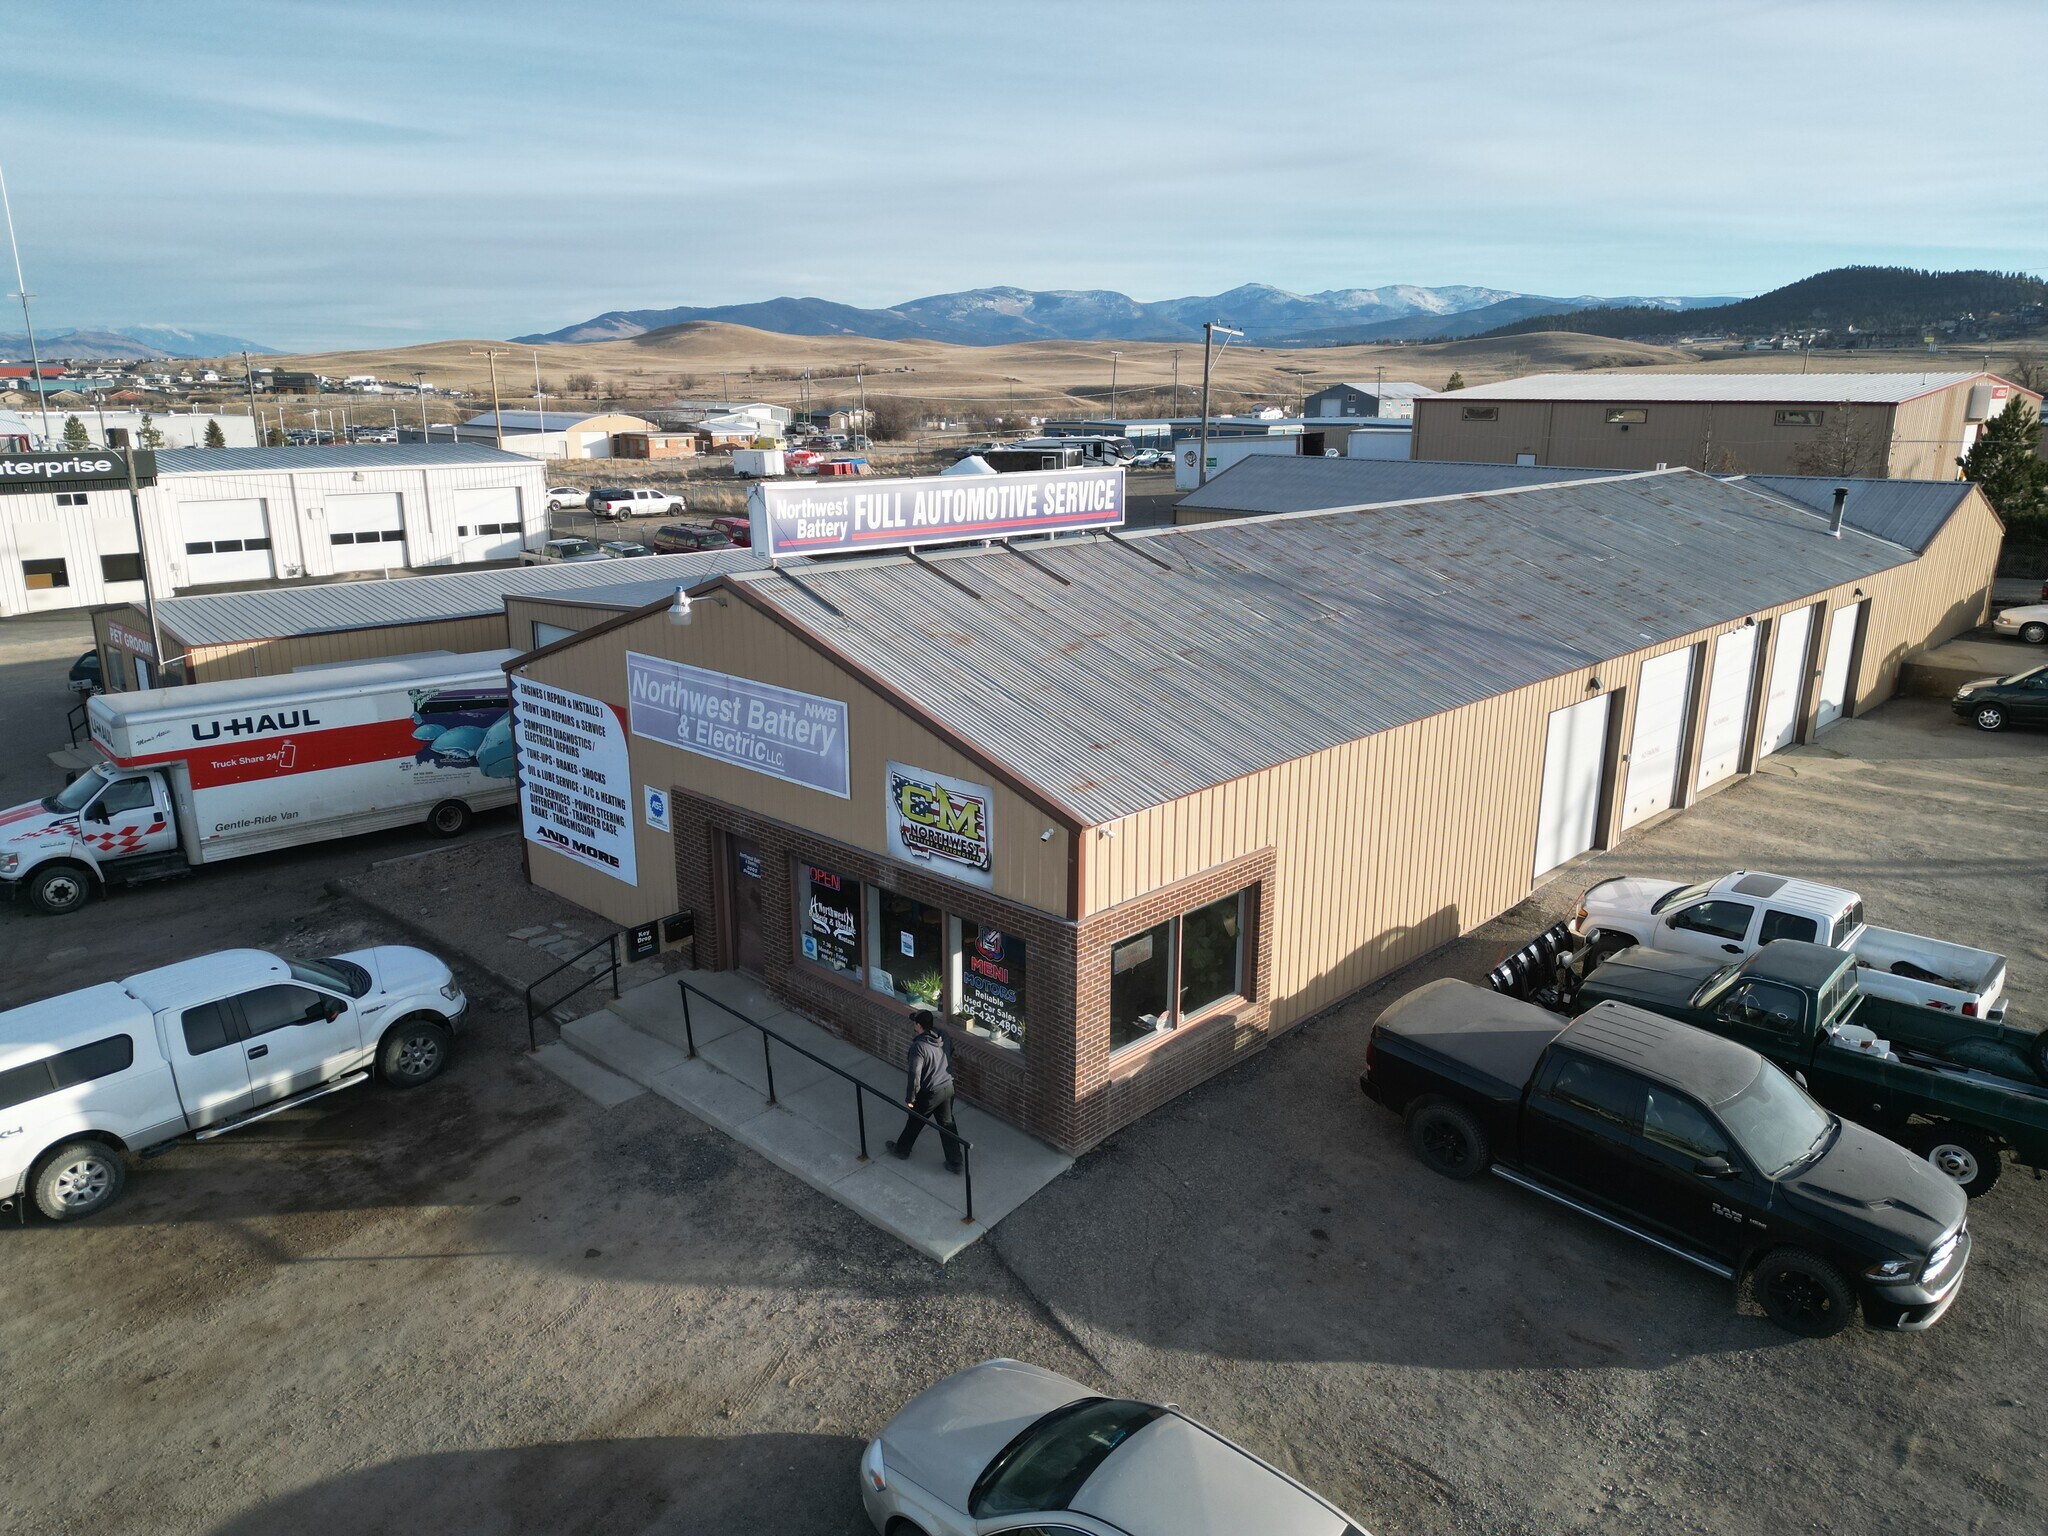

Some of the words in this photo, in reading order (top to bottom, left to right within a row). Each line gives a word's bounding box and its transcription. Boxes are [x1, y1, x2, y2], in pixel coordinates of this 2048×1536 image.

[0, 457, 112, 478] terprise
[776, 497, 848, 520] Northwest
[854, 493, 906, 530] FULL
[913, 484, 1037, 526] AUTOMOTIVE
[1043, 479, 1116, 515] SERVICE
[797, 519, 848, 542] Battery
[109, 627, 123, 645] PET
[521, 683, 543, 700] ENGINES
[547, 692, 567, 707] REPAIR
[573, 699, 600, 718] INSTALLS
[633, 669, 741, 725] Northwest
[748, 699, 837, 757] Battery
[804, 702, 837, 723] NWB
[191, 709, 321, 741] U-HAUL
[522, 701, 539, 715] FRONT
[540, 706, 550, 719] END
[551, 709, 575, 728] REPAIRS
[581, 720, 606, 738] SERVICE
[524, 719, 553, 737] COMPUTER
[553, 728, 592, 751] DIAGNOSTICS
[525, 731, 555, 750] ELECTRICAL
[556, 742, 580, 758] REPAIRS
[677, 714, 689, 739] &
[696, 719, 766, 761] Electric
[211, 758, 238, 769] Truck
[238, 755, 265, 765] Share
[266, 750, 286, 762] 24/7
[526, 747, 553, 765] TUNE-UPS
[556, 758, 578, 775] BRAKES
[582, 767, 606, 784] SHOCKS
[527, 765, 536, 776] OIL
[541, 770, 555, 783] LUBE
[556, 775, 579, 793] SERVICE
[583, 785, 594, 799] A/C
[600, 792, 626, 810] HEATING
[529, 781, 544, 796] FLUID
[544, 788, 571, 806] SERVICES
[574, 799, 596, 816] POWER
[215, 814, 278, 833] Gentle-Ride
[280, 810, 299, 821] Van
[530, 793, 568, 816] DIFFERENTIALS
[572, 809, 601, 829] TRANSFER
[531, 804, 548, 820] BRAKE
[552, 813, 596, 839] TRANSMISSION
[536, 826, 569, 846] AND
[572, 839, 620, 868] MORE
[910, 824, 981, 855] NORTHWEST
[942, 846, 980, 861] AUTOMOTIVE
[809, 866, 839, 890] OPEN
[818, 902, 847, 923] Northwest
[637, 935, 652, 944] Drop
[638, 929, 650, 938] Key
[971, 956, 1009, 984] MENI
[963, 971, 1017, 1003] MOTORS
[975, 989, 1004, 1008] Reliable
[962, 1003, 1023, 1036] 06-422-4805
[964, 995, 982, 1008] Used
[983, 1001, 995, 1013] Car
[996, 1007, 1016, 1023] Sales
[1712, 1206, 1742, 1223] 1500
